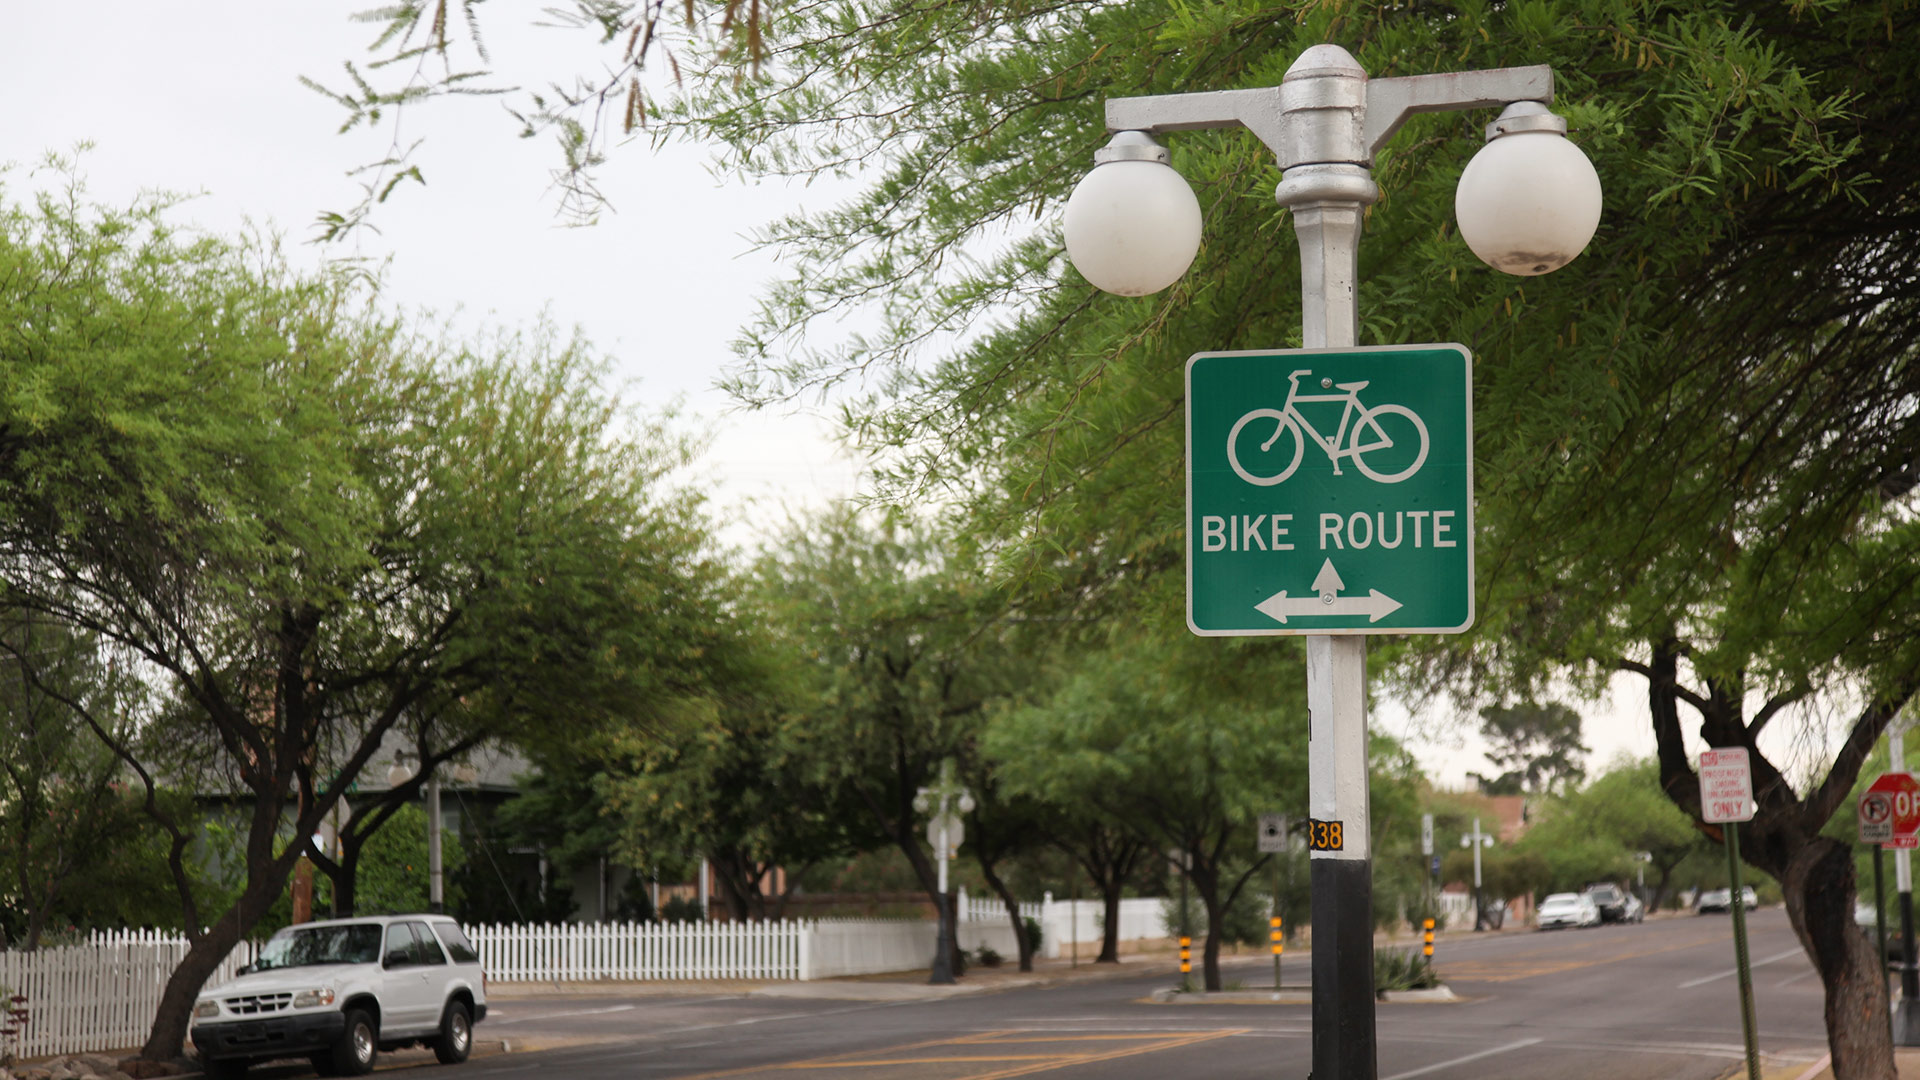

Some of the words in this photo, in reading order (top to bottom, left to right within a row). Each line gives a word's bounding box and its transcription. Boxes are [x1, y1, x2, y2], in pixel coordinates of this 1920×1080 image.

[1202, 514, 1295, 552] BIKE
[1319, 510, 1457, 550] ROUTE
[1713, 801, 1742, 818] ONLY
[1892, 791, 1920, 816] OP
